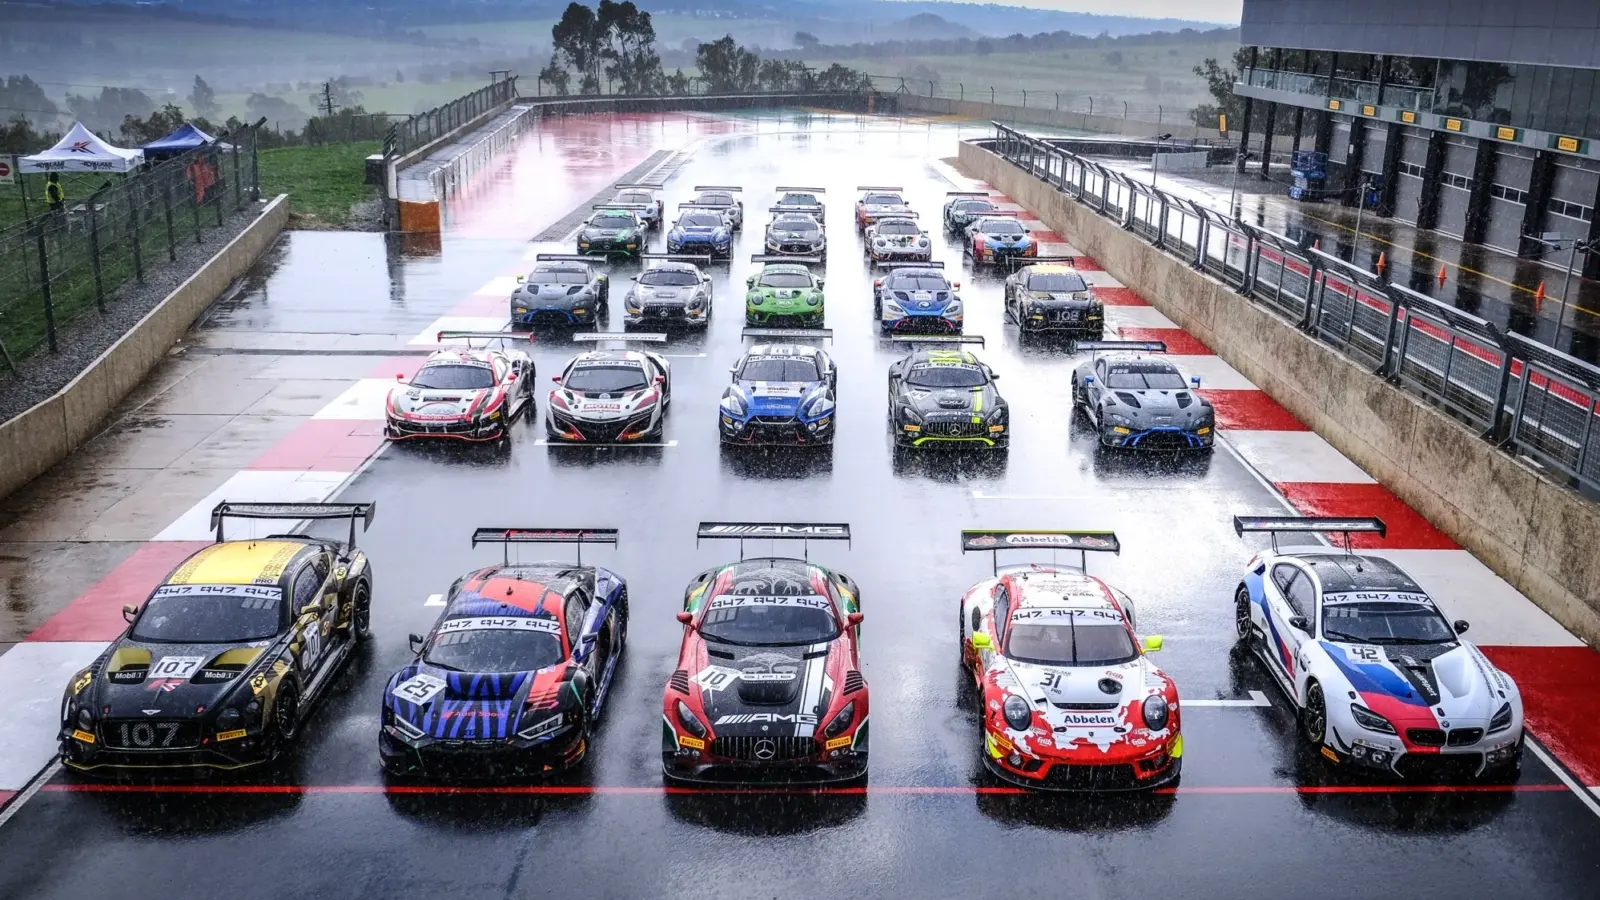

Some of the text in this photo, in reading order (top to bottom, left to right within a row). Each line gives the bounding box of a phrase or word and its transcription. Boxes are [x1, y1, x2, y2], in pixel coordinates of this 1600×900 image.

[1351, 648, 1379, 659] 42
[154, 661, 198, 674] 107
[204, 671, 225, 679] Mobil
[702, 671, 728, 685] 10
[1040, 672, 1062, 689] 31
[403, 680, 437, 698] 25
[749, 713, 818, 725] AMG
[1064, 715, 1115, 724] Abbelen
[120, 722, 180, 746] 107
[682, 738, 704, 748] PIRELLI
[827, 737, 850, 748] PIRELLI
